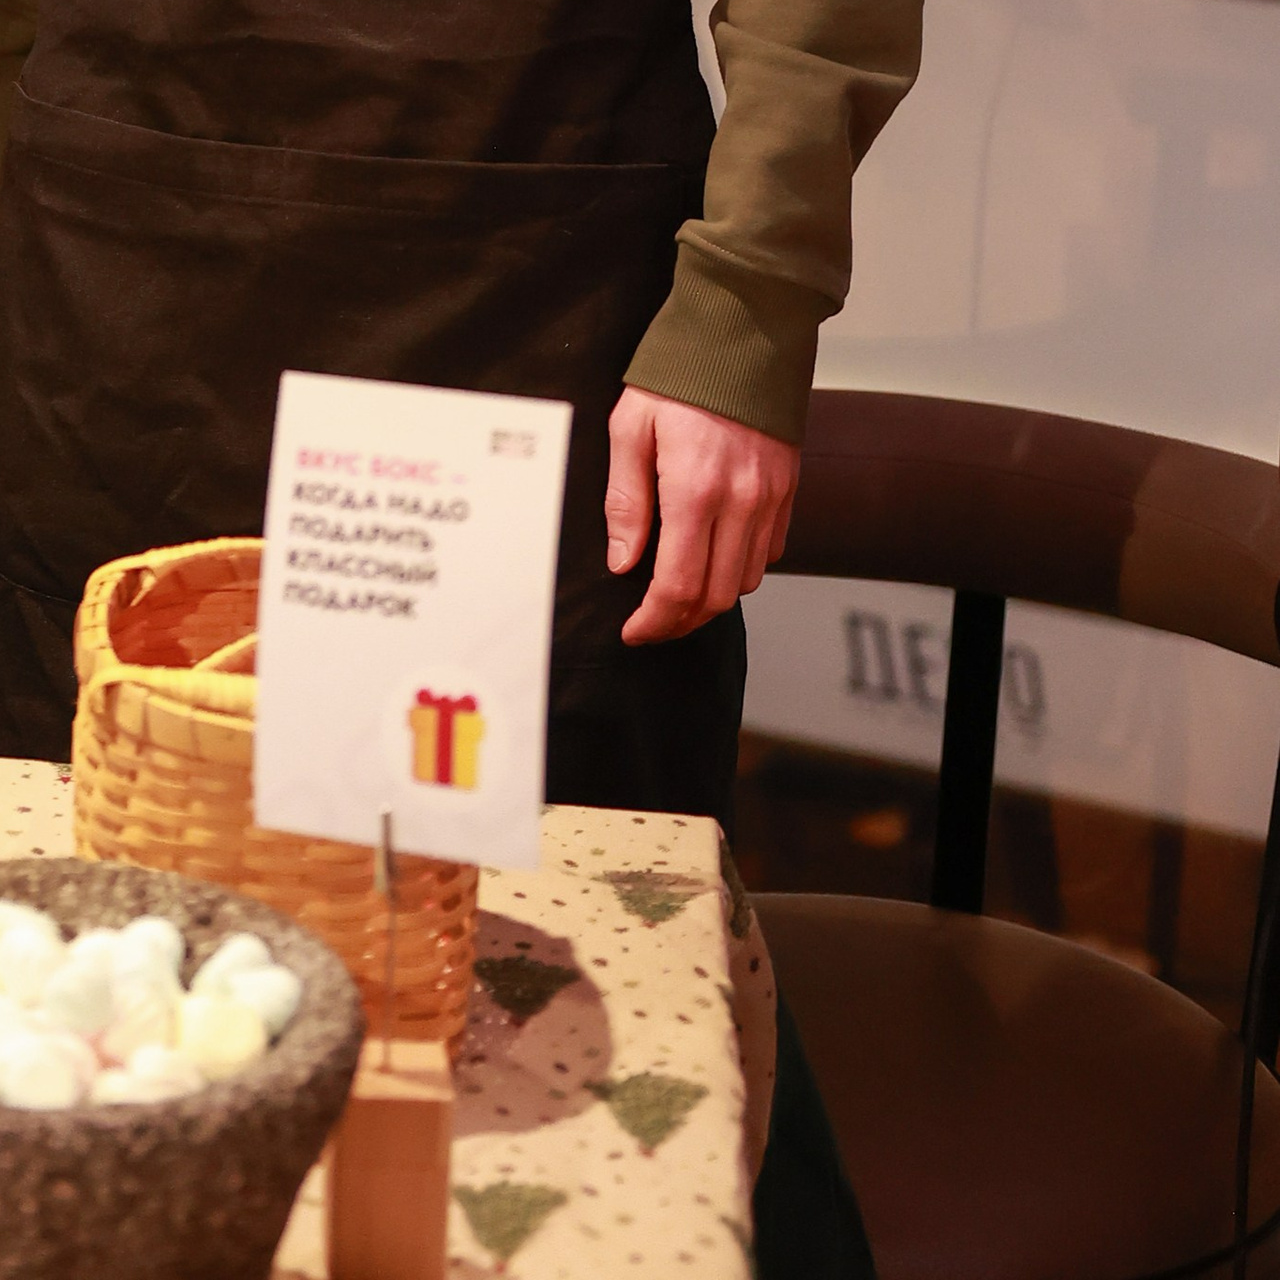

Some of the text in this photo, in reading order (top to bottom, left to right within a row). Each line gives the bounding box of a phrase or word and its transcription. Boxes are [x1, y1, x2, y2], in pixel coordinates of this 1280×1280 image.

[296, 447, 362, 477] ВКУС
[370, 455, 443, 486] БОКС
[292, 482, 471, 523] КОГДА НАДО
[288, 511, 436, 553] ПОДАРИТЬ
[285, 547, 440, 587] КЛАССНЫЙ
[282, 579, 419, 621] ПОДАРОК
